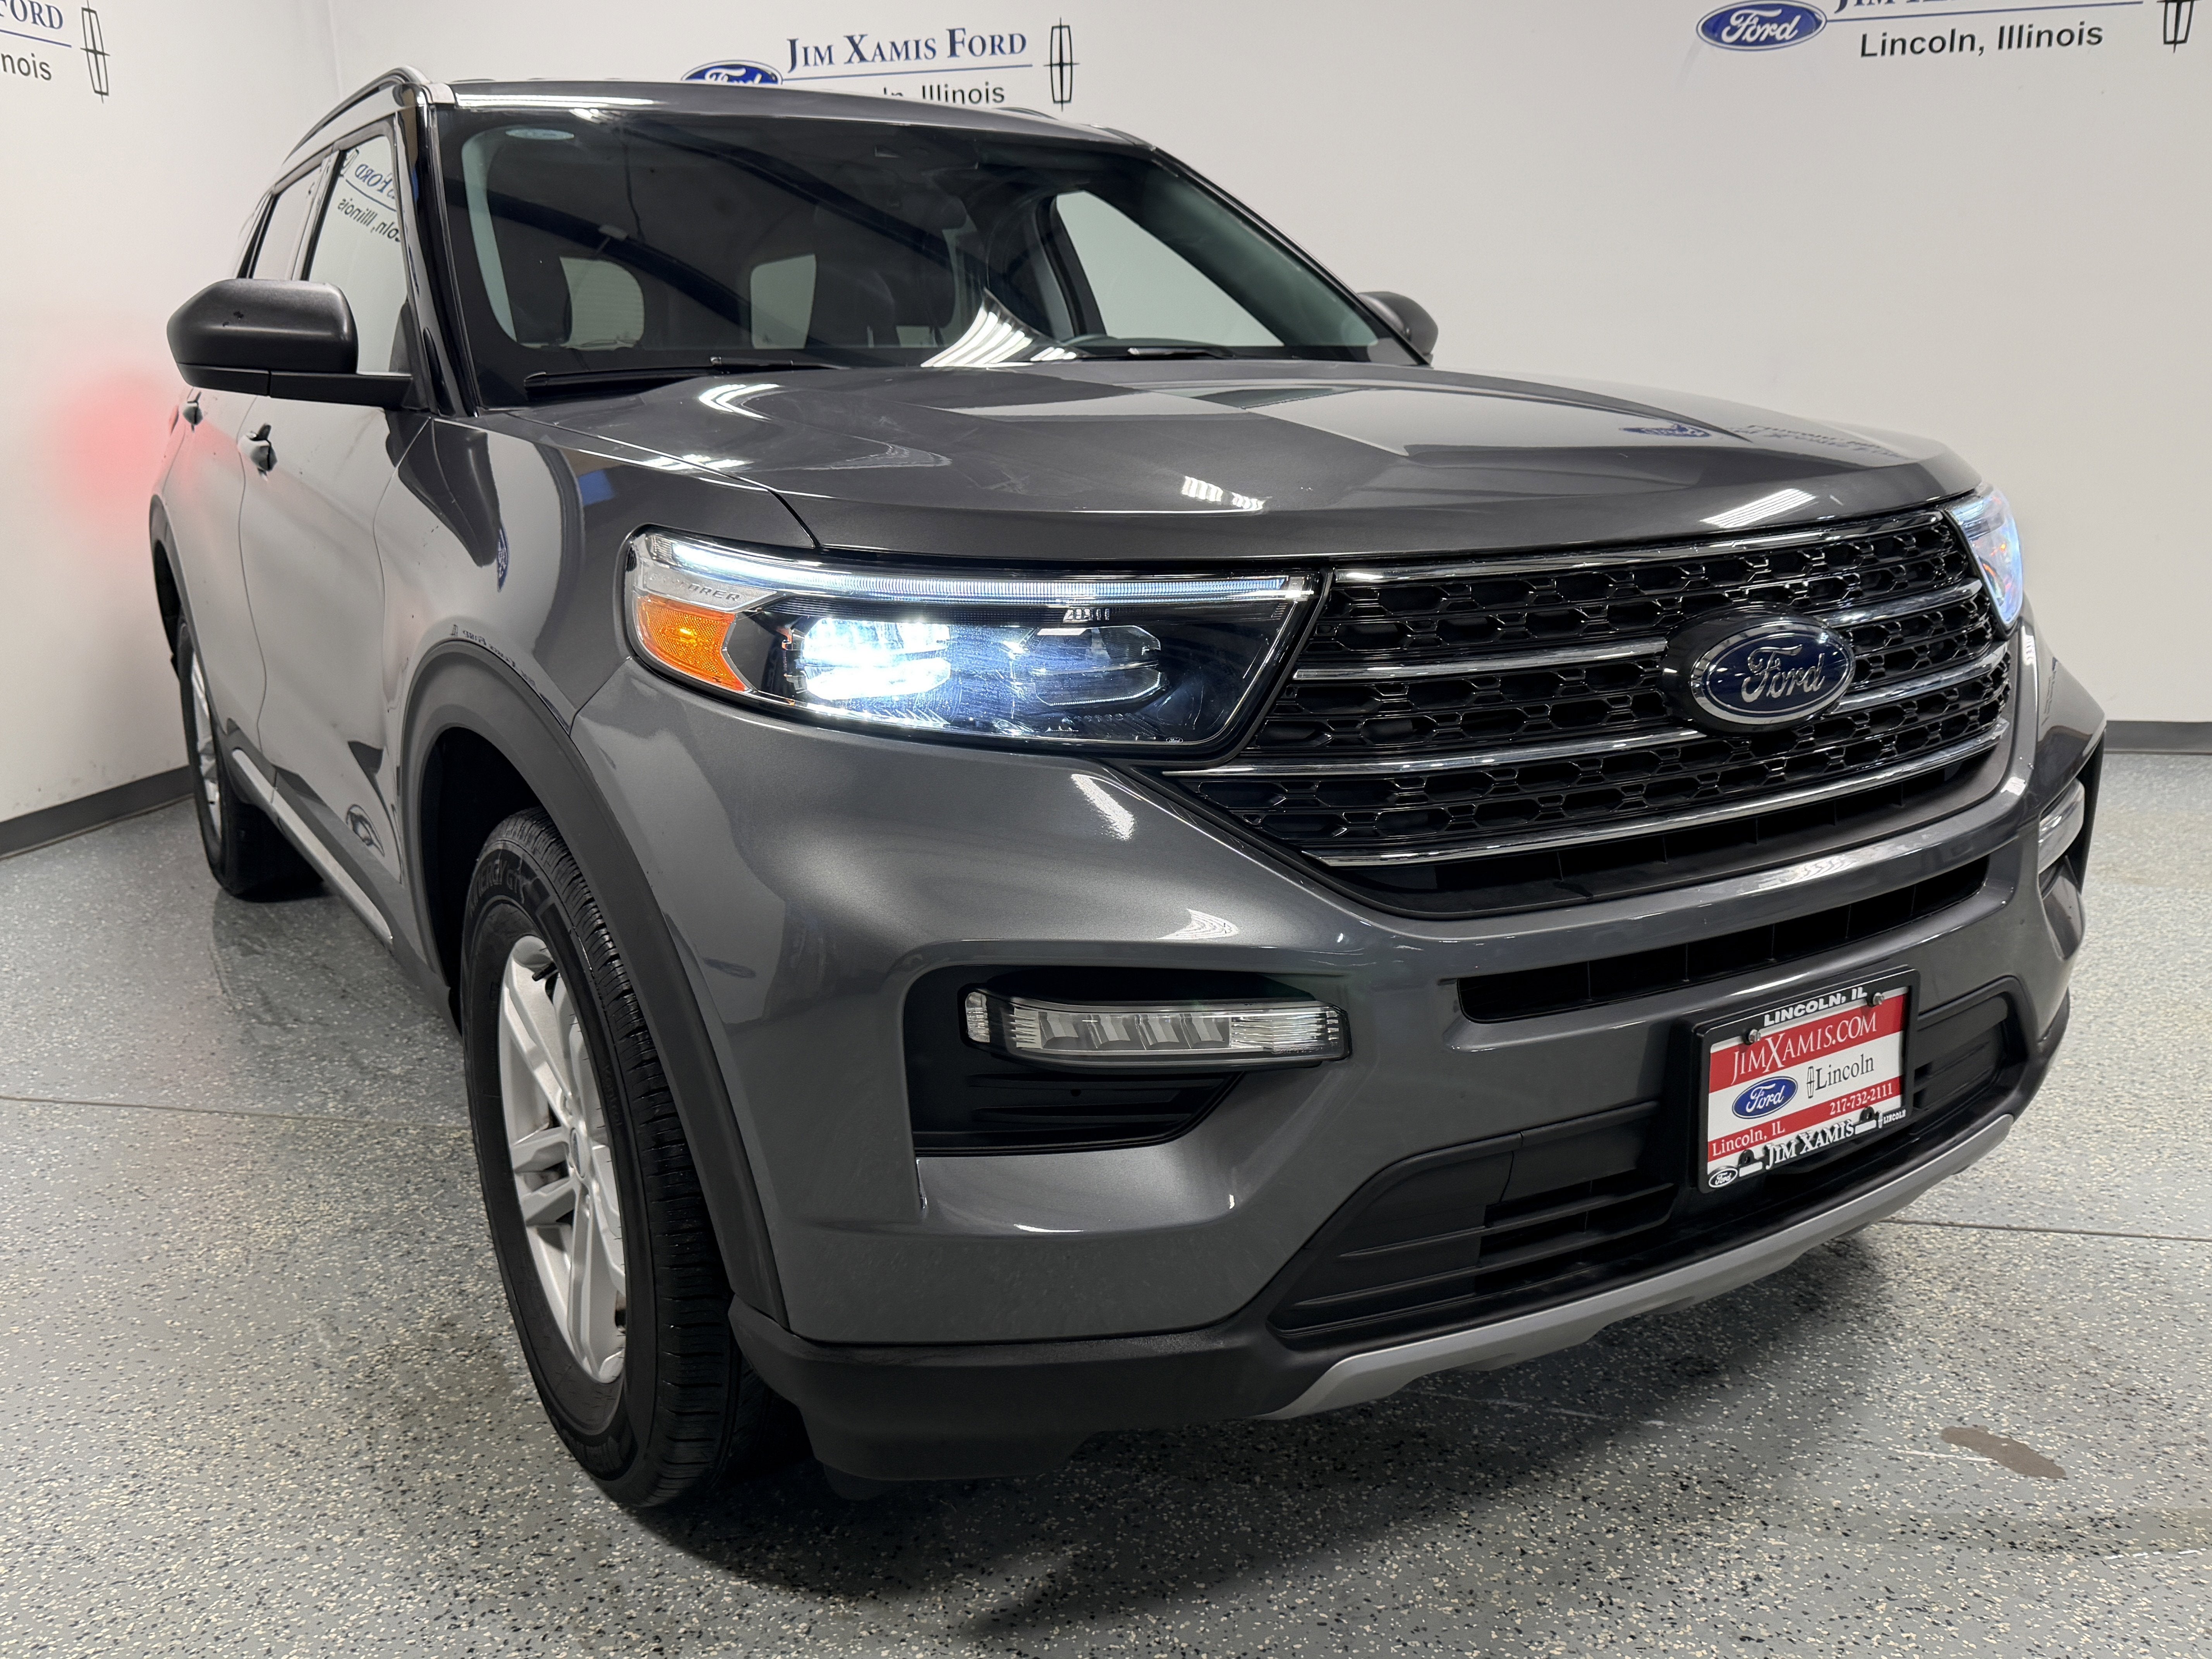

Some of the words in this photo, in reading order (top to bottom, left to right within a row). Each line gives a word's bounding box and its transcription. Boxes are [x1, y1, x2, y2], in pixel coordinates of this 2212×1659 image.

[1721, 9, 1801, 43] Ford
[1861, 28, 1984, 58] Lincoln,
[1998, 21, 2103, 50] Illinois
[787, 38, 835, 74] JIM
[843, 34, 936, 65] XAMIS
[946, 27, 1026, 58] FORD
[922, 81, 1005, 105] Illinois
[1741, 644, 1826, 702] Ford
[1764, 993, 1846, 1027] LINCOLN,
[1851, 987, 1868, 1000] IL
[1731, 1012, 1877, 1085] JIMXAMIS.COM
[1815, 1054, 1874, 1091] Lincoln
[1746, 1085, 1785, 1113] Ford
[1829, 1082, 1893, 1115] 217-732-2111
[1883, 1109, 1906, 1125] LINCOLN
[1712, 1128, 1767, 1157] Lincoln,
[1772, 1121, 1785, 1136] IL
[1765, 1141, 1797, 1170] JIM
[1799, 1121, 1854, 1155] XAMIS
[1715, 1172, 1732, 1185] Ford
